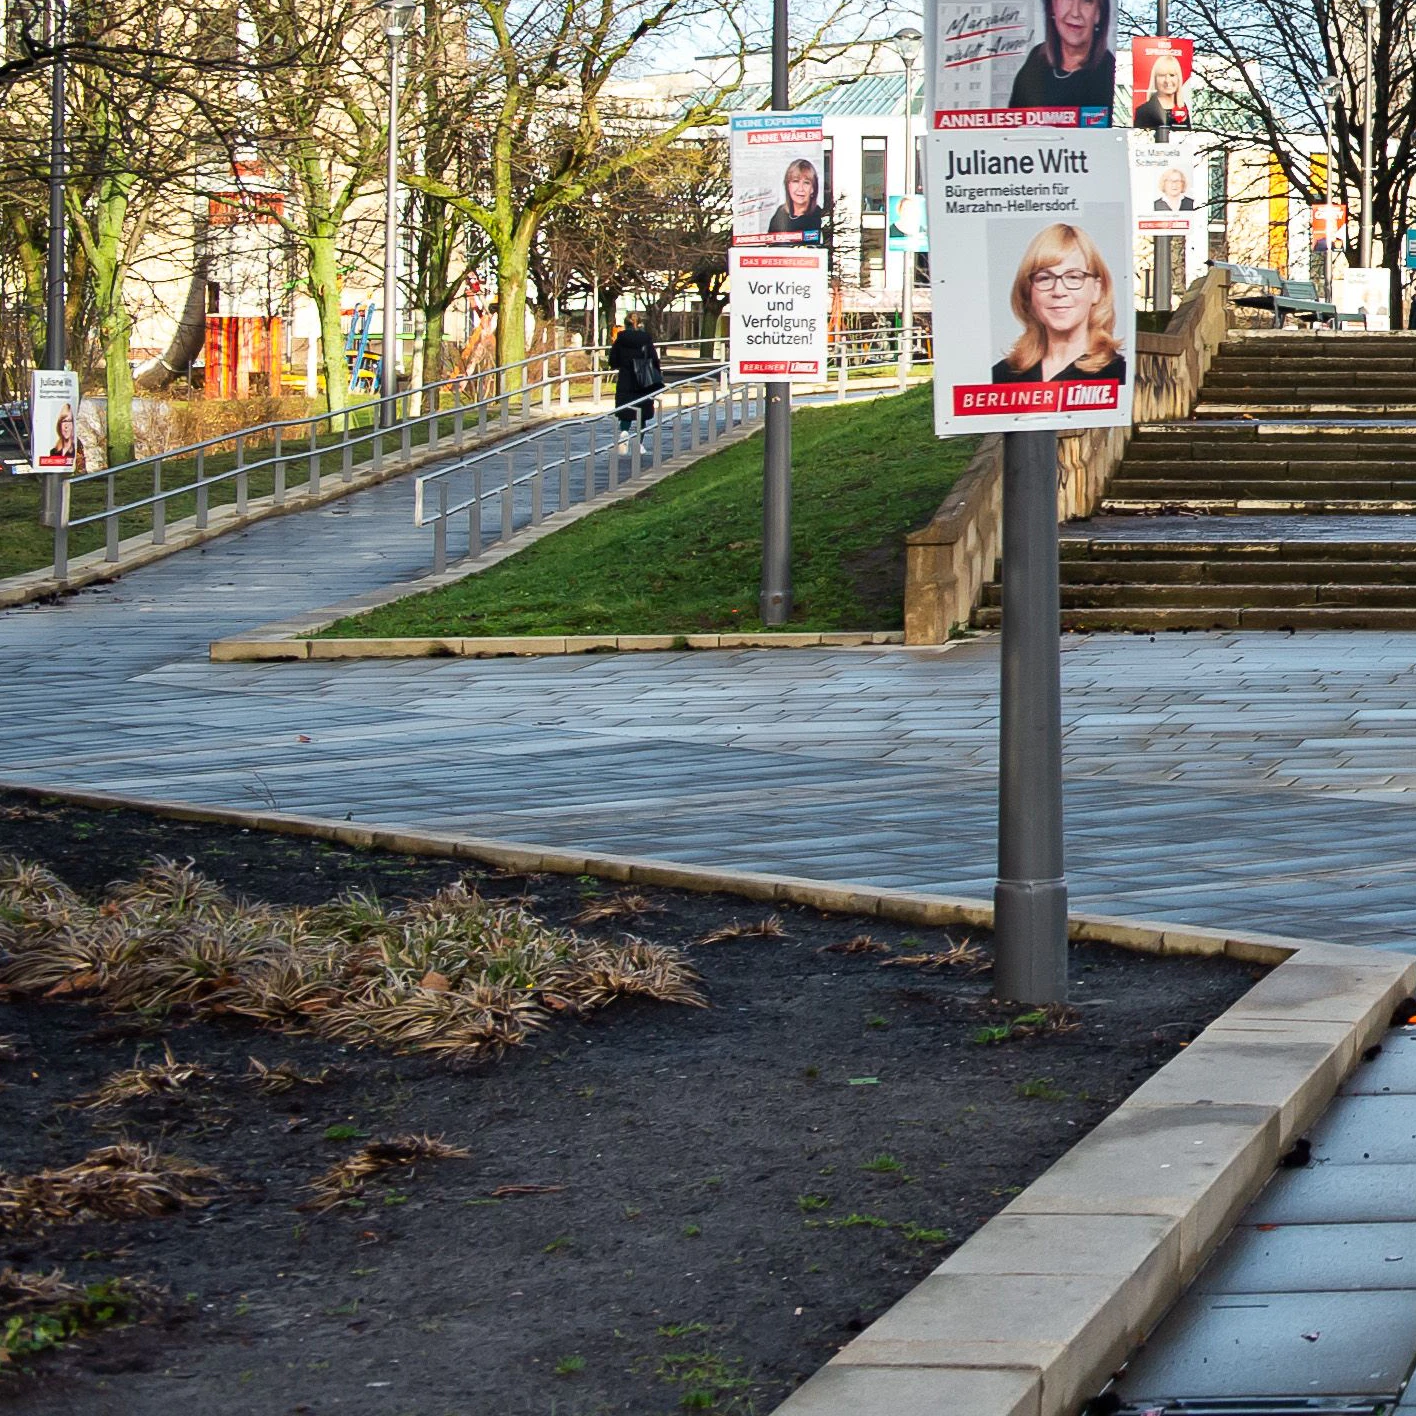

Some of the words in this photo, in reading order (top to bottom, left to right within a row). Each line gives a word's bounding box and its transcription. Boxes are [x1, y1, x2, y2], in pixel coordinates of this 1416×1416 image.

[735, 119, 763, 128] KEINE
[938, 112, 1023, 128] ANNELIESE
[749, 133, 779, 143] ANNE
[945, 149, 1034, 180] Juliane
[1038, 148, 1089, 174] Witt
[945, 184, 1051, 200] Bürgermeisterin
[1052, 183, 1070, 196] für
[945, 199, 1080, 214] Marzahn-Hellersdorf.
[748, 282, 773, 295] Vor
[775, 282, 811, 299] Krieg
[767, 298, 794, 311] und
[741, 314, 816, 332] Verfolgung
[746, 331, 813, 345] schützen!
[963, 390, 1054, 408] BERLINER
